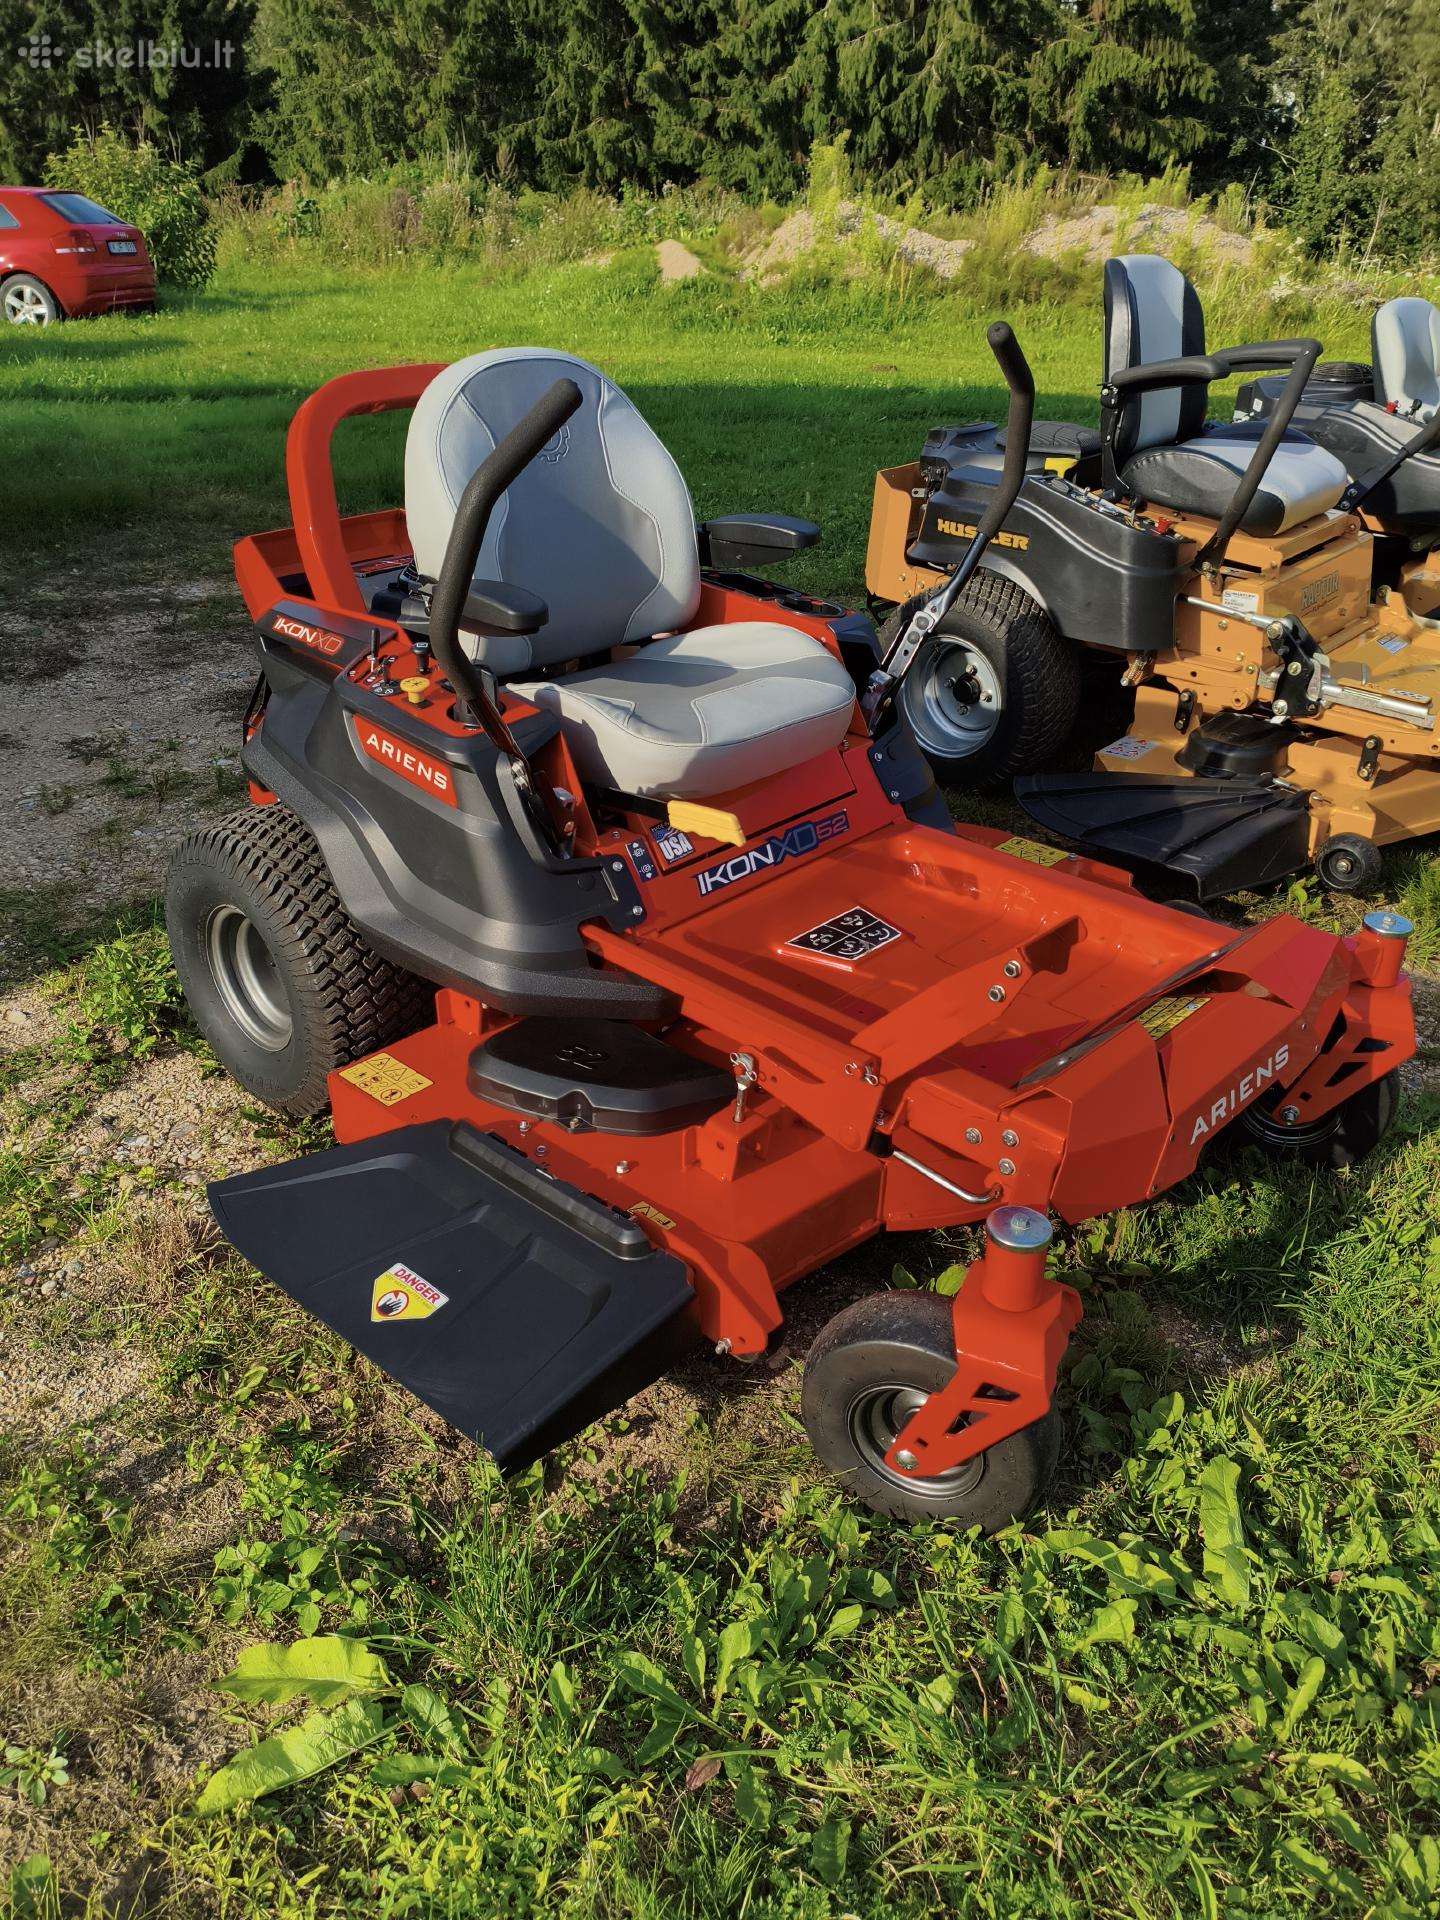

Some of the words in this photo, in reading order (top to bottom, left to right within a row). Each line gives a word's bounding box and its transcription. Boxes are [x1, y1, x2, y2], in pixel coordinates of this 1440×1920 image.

[937, 518, 1029, 551] HUSER
[366, 733, 448, 790] ARIENS
[658, 832, 694, 860] USA
[1190, 1044, 1289, 1146] ARIENS
[394, 1268, 440, 1304] DANGER
